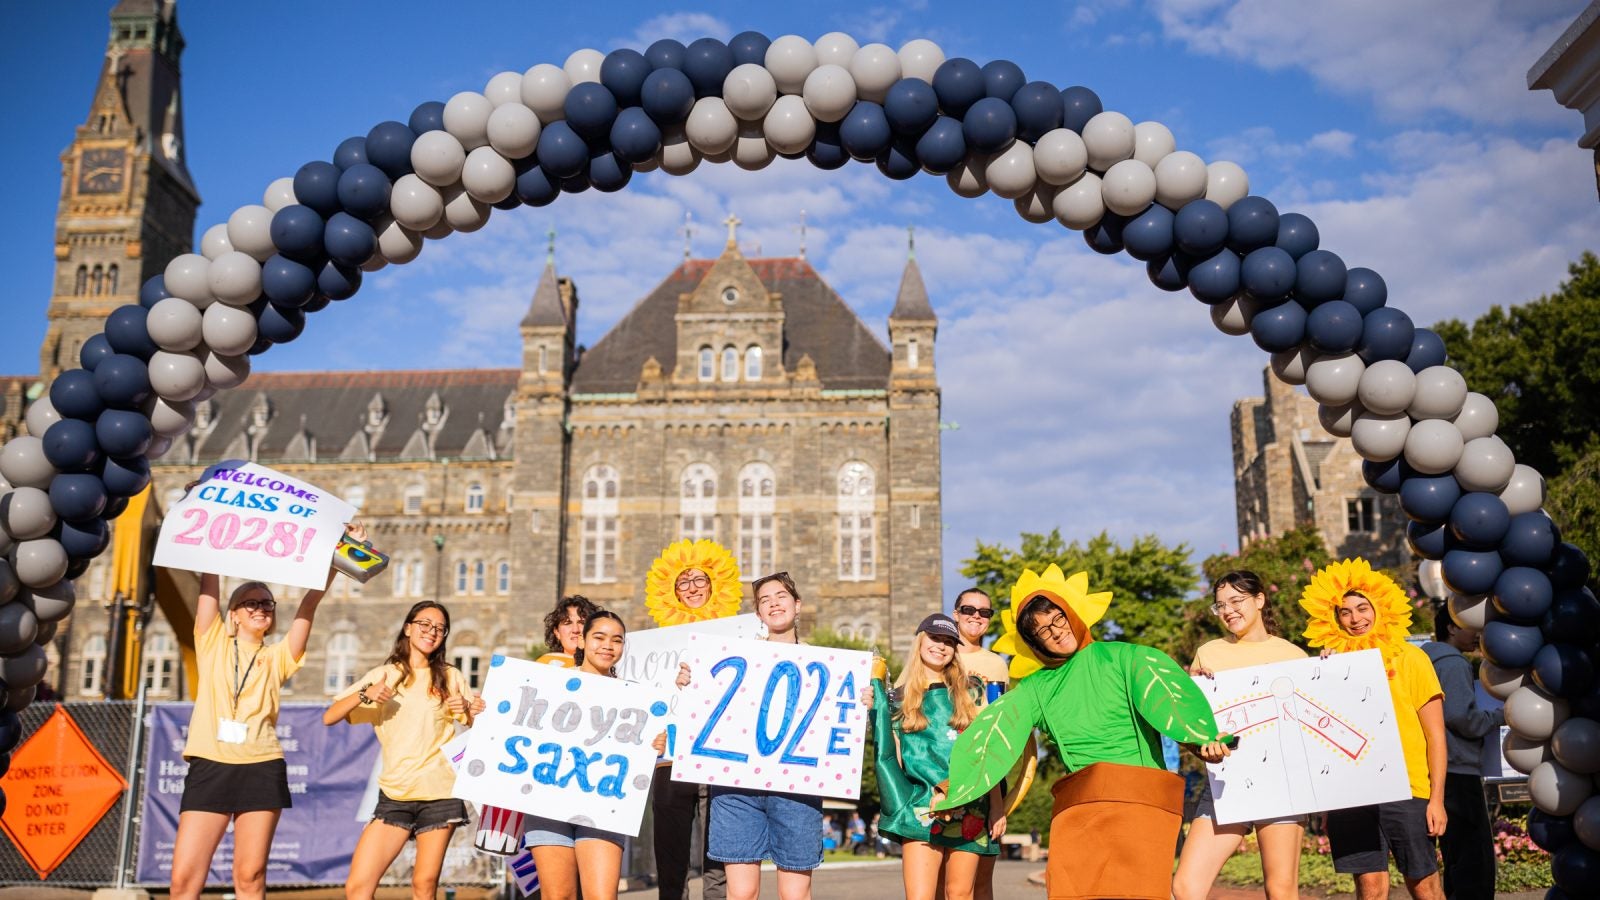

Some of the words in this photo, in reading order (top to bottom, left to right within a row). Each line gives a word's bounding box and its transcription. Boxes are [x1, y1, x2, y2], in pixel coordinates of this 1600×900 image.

[198, 486, 280, 512] CLASS
[289, 504, 317, 518] OF
[213, 468, 320, 503] WELCOME
[172, 508, 317, 563] 2028!
[512, 685, 649, 746] hoya
[497, 735, 629, 799] saxa
[33, 784, 64, 798] ZONE
[25, 803, 42, 817] DO
[45, 802, 70, 816] NOT
[26, 822, 66, 837] ENTER
